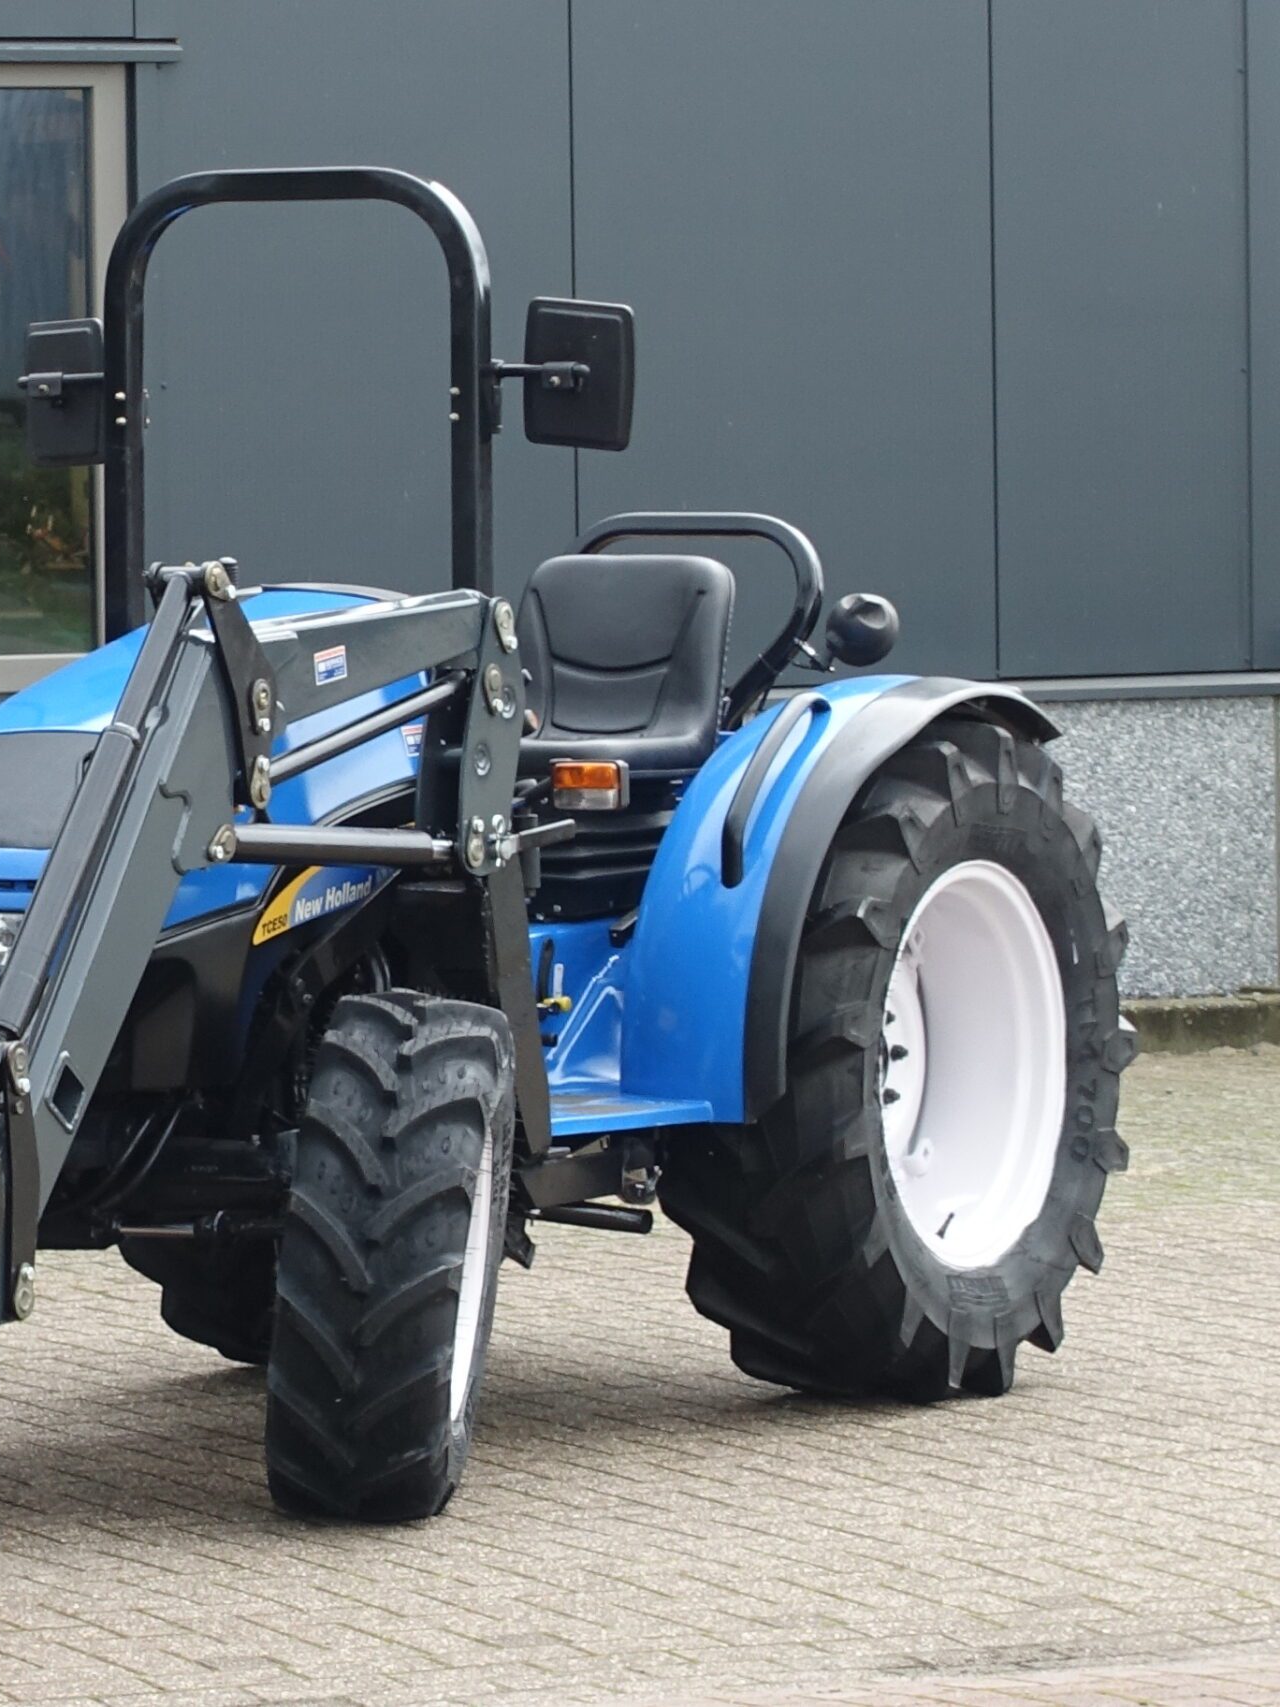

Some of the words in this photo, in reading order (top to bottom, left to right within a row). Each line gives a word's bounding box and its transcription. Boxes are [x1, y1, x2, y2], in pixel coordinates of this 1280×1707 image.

[295, 896, 324, 923] New
[325, 875, 373, 911] Holland
[261, 913, 288, 937] TCE50
